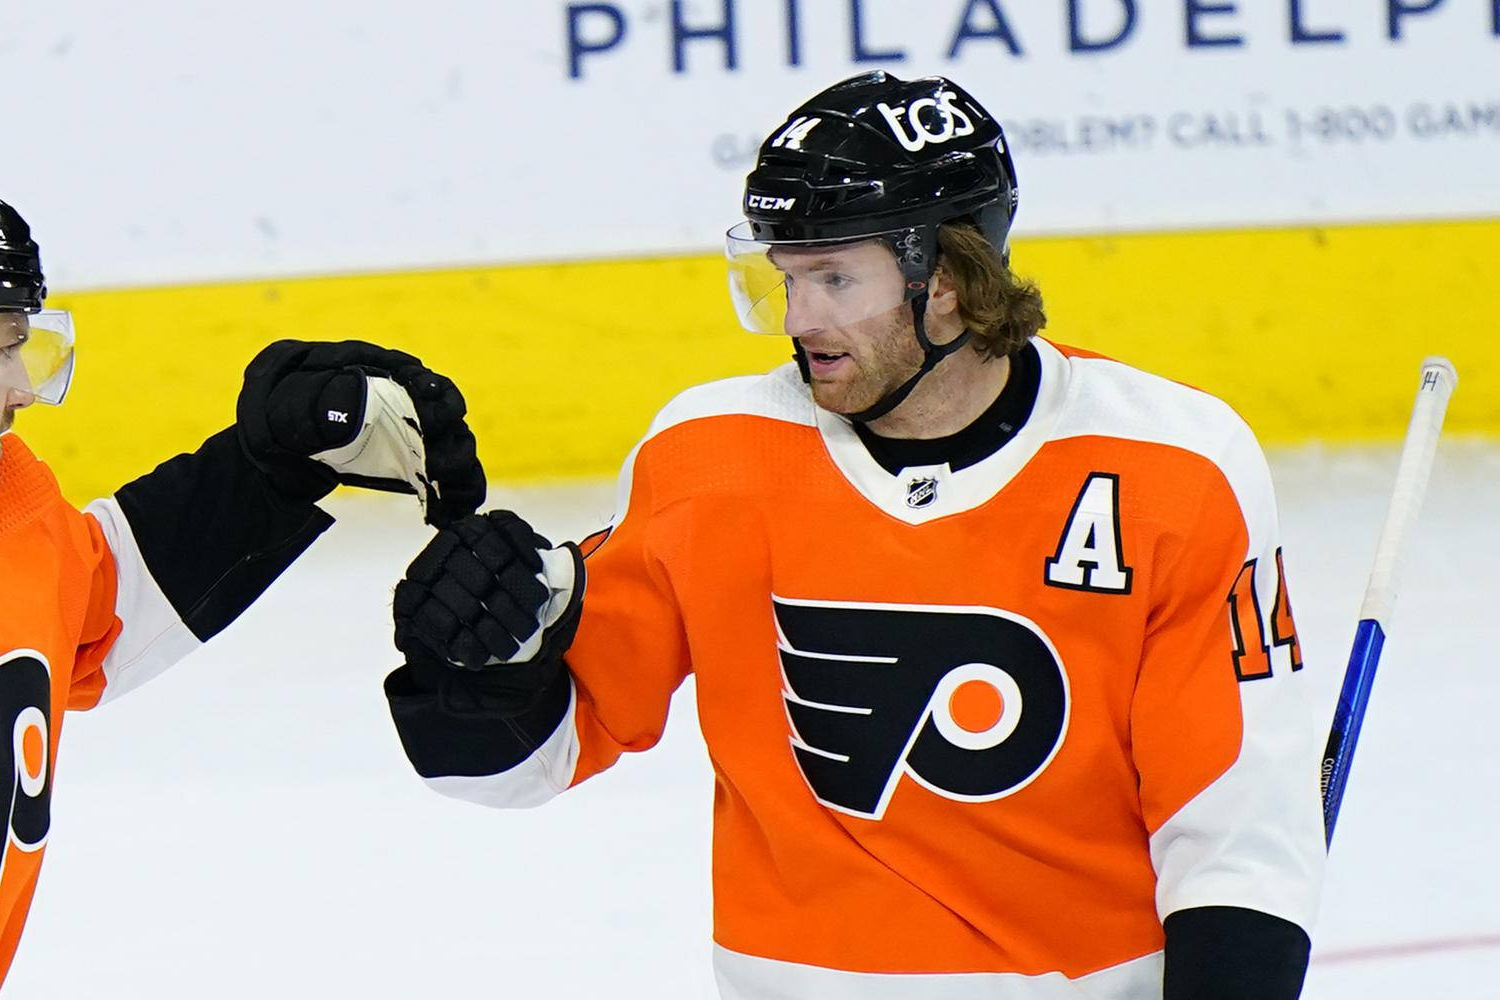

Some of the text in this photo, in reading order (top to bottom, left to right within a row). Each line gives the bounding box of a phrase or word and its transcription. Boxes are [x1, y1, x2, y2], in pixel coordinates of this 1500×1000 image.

[566, 0, 1500, 79] PHILADELP
[771, 116, 822, 150] 14
[1002, 113, 1157, 156] OBLEM?
[1167, 109, 1274, 149] CALL
[747, 195, 796, 211] CCM
[327, 410, 349, 423] STX
[1044, 471, 1134, 595] A
[1228, 546, 1304, 682] 14
